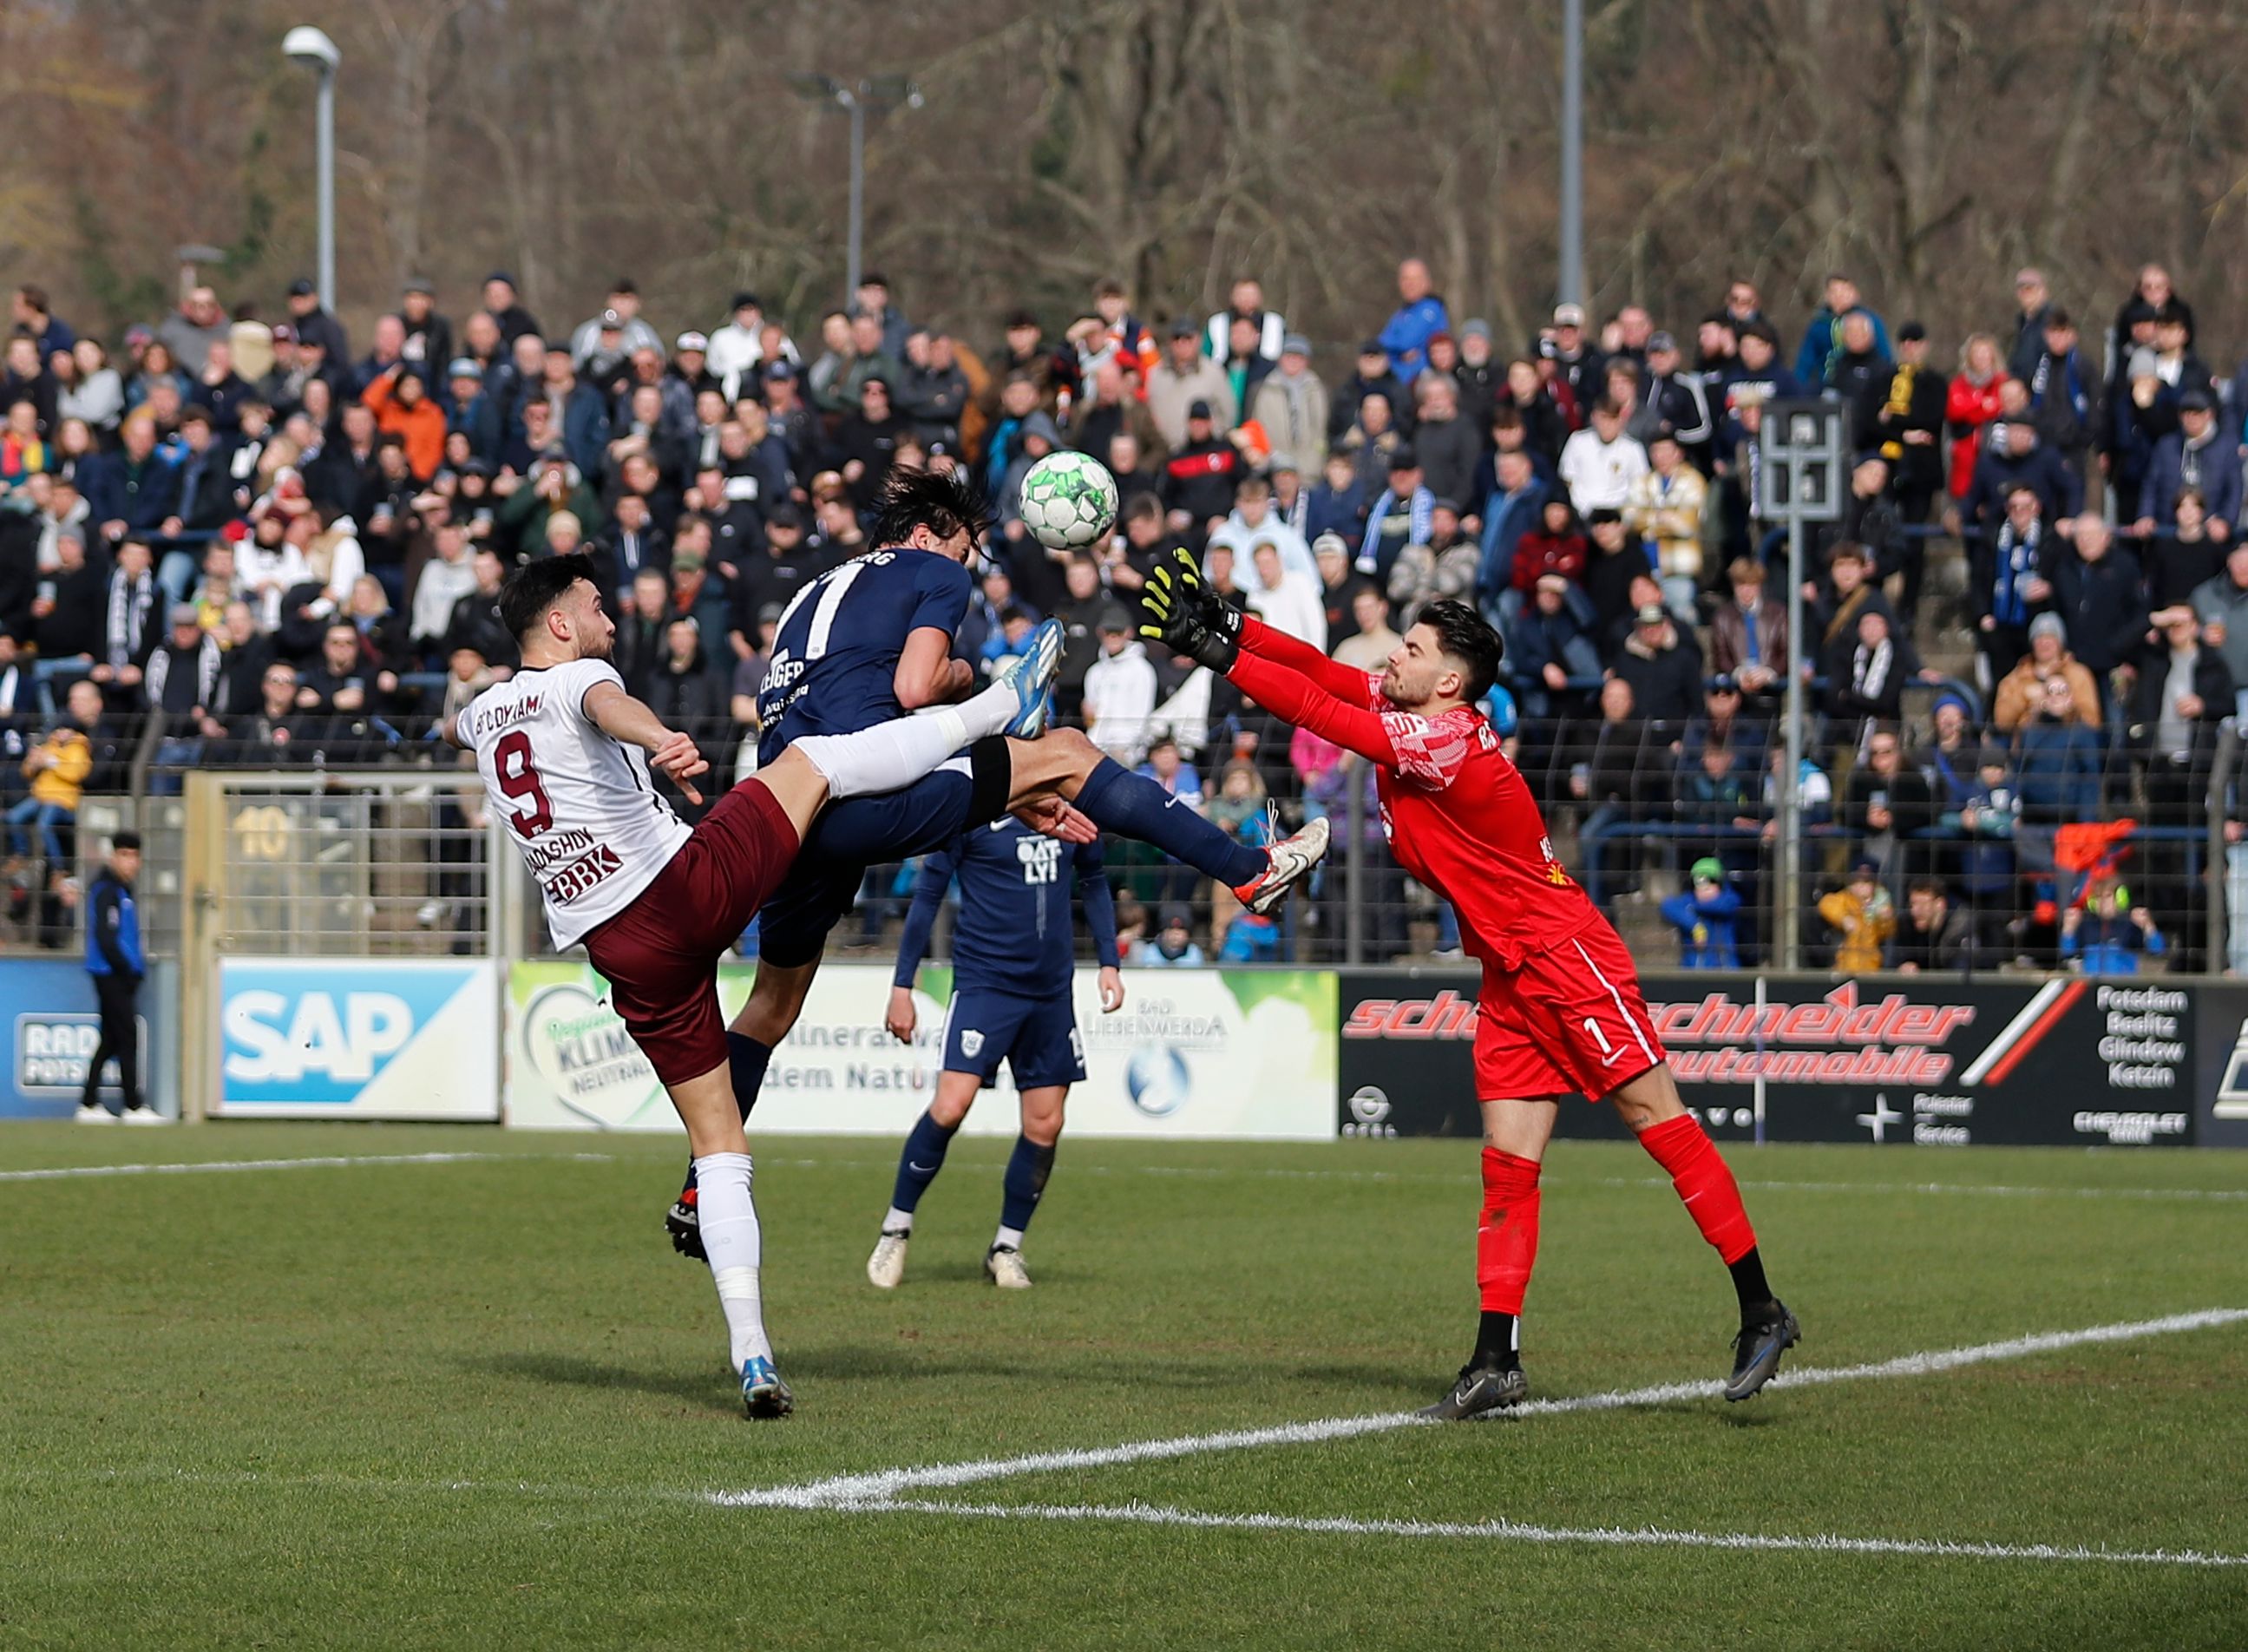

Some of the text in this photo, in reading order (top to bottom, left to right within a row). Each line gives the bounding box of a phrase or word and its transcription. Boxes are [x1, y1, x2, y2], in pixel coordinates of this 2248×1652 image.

[493, 729, 554, 840] 9
[234, 804, 287, 859] 10
[554, 845, 622, 901] BBK
[1025, 860, 1058, 885] LY!
[2096, 985, 2189, 1013] Potsdam
[224, 989, 415, 1082] SAP
[1583, 1017, 1612, 1054] 1
[2098, 1035, 2186, 1064] Glindow
